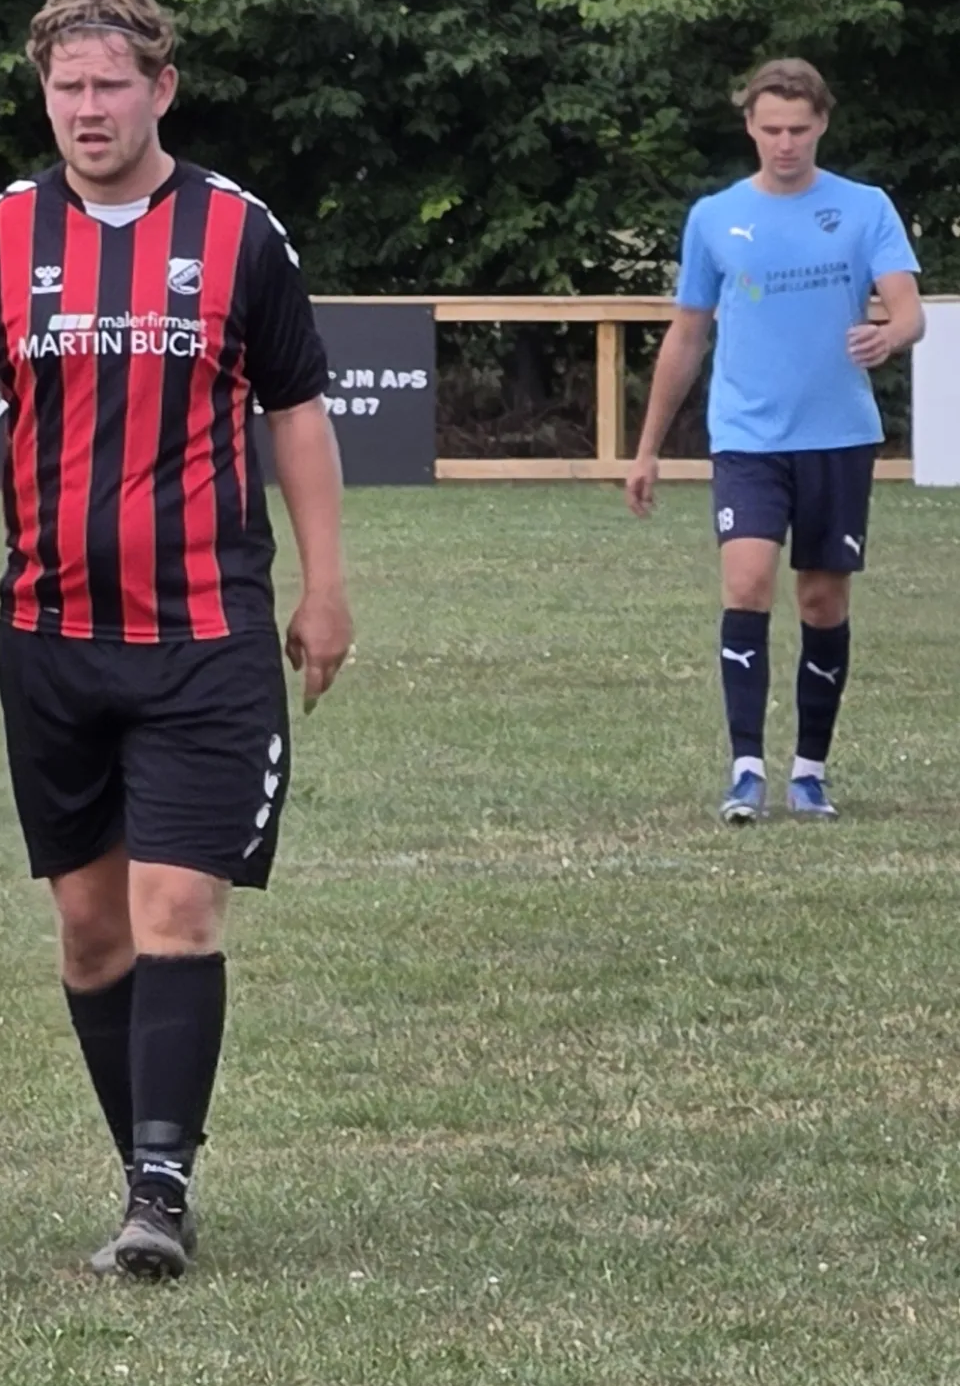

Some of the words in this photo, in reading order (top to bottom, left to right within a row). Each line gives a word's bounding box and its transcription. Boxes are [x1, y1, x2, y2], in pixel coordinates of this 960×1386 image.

[98, 311, 208, 334] malerfirmaet
[17, 331, 122, 361] MARTIN
[130, 330, 208, 359] BUCH
[340, 369, 375, 389] JM
[351, 397, 380, 416] 87
[717, 507, 735, 534] 18
